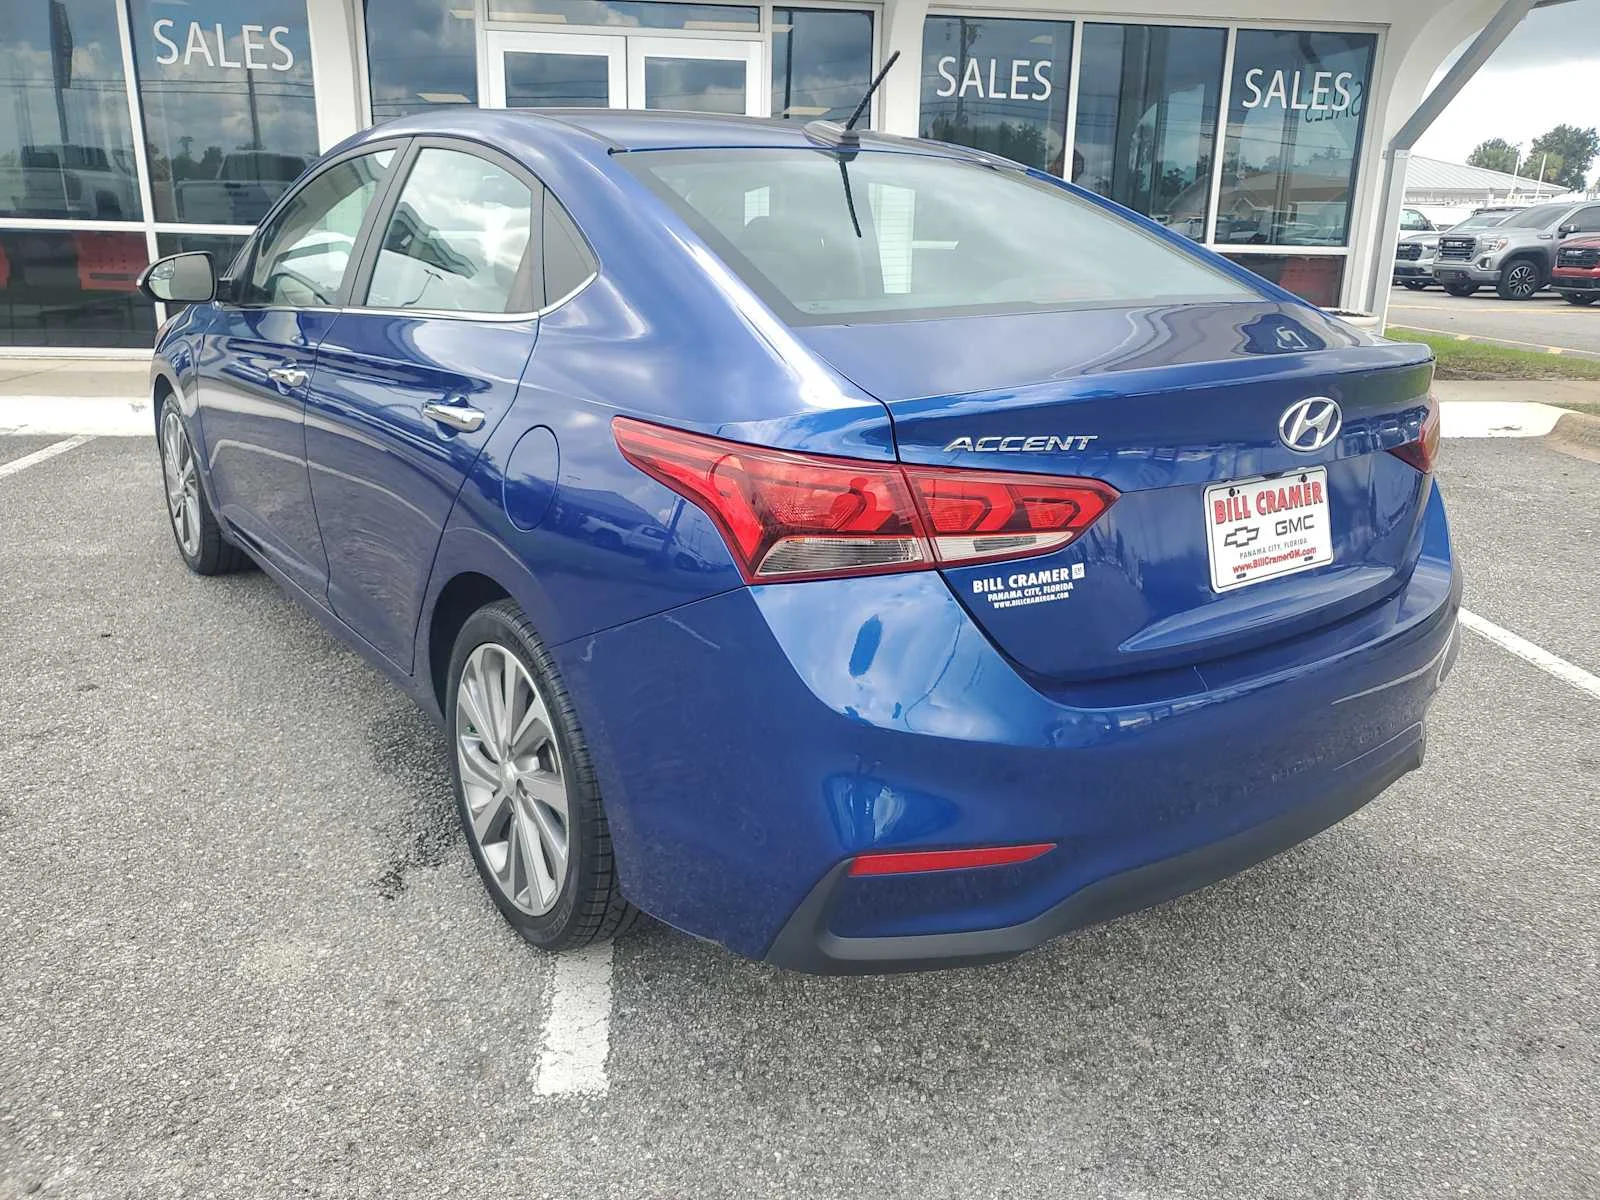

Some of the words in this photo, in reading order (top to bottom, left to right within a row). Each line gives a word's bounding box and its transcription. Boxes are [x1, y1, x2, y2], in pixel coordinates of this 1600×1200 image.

[153, 19, 294, 71] SALES
[936, 56, 1052, 101] SALES
[1242, 68, 1353, 111] SALES
[944, 435, 1098, 452] ACCENT
[1214, 495, 1251, 525] BILL
[1256, 481, 1323, 516] CRAMER
[1275, 514, 1315, 537] GMC
[1240, 547, 1267, 560] PANAMA
[1284, 537, 1308, 549] FLORIDA
[973, 577, 1004, 593] BILL
[1008, 568, 1070, 588] CRAMER
[987, 590, 1023, 602] PANAMA
[1023, 587, 1042, 597] CITY,
[1043, 582, 1074, 594] FLORIDA
